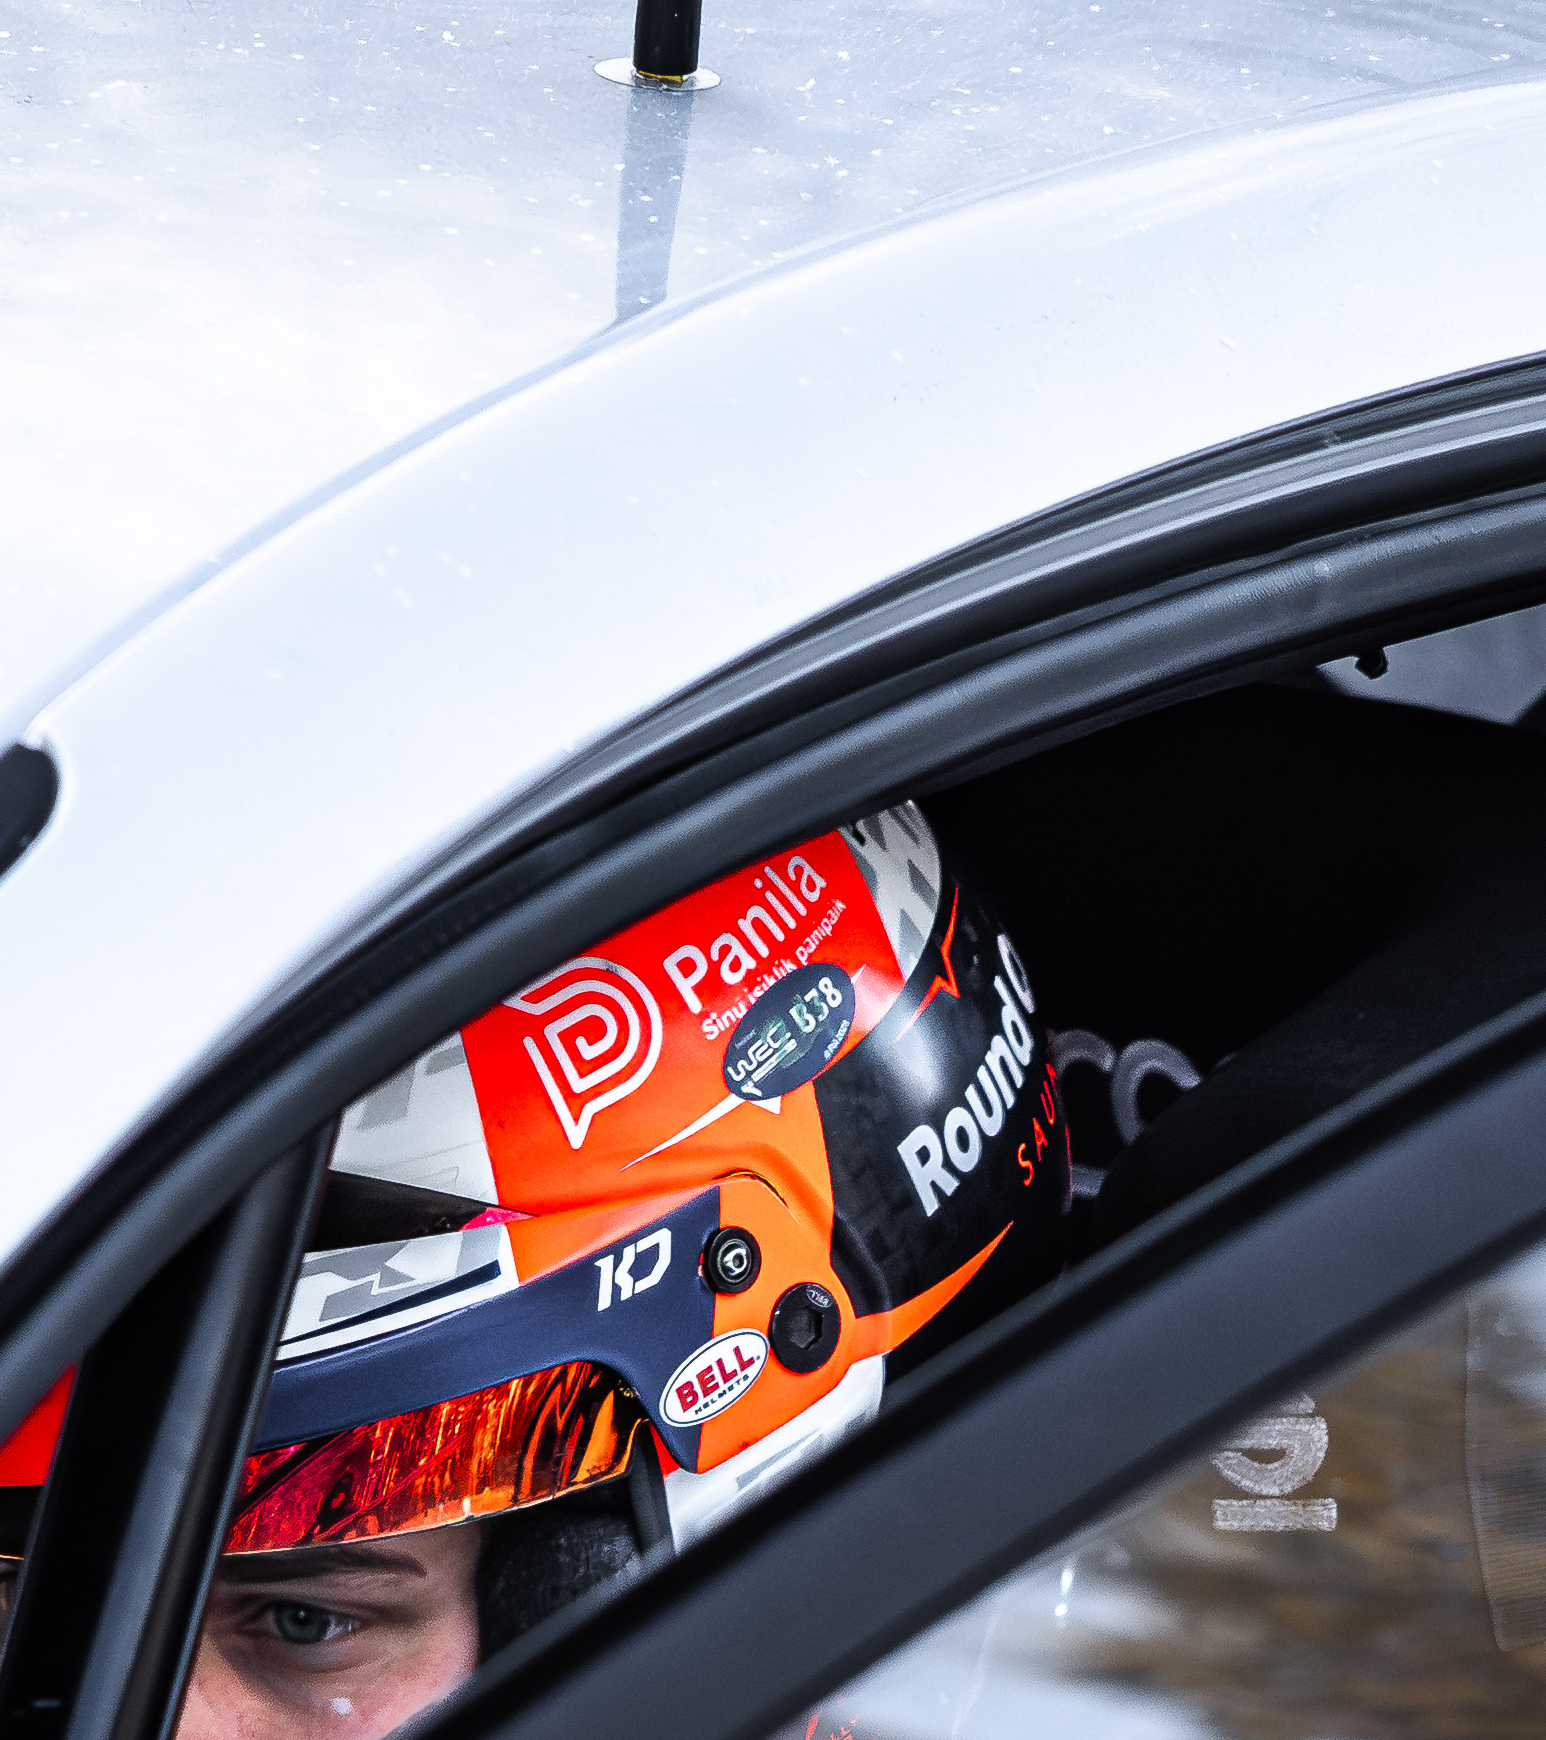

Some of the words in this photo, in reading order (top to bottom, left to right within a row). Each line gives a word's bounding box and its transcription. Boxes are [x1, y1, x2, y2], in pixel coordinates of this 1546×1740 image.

[663, 855, 827, 1014] Panila
[702, 999, 749, 1040] Sinu
[675, 1345, 756, 1413] BELL
[694, 1374, 750, 1415] HELMETS
